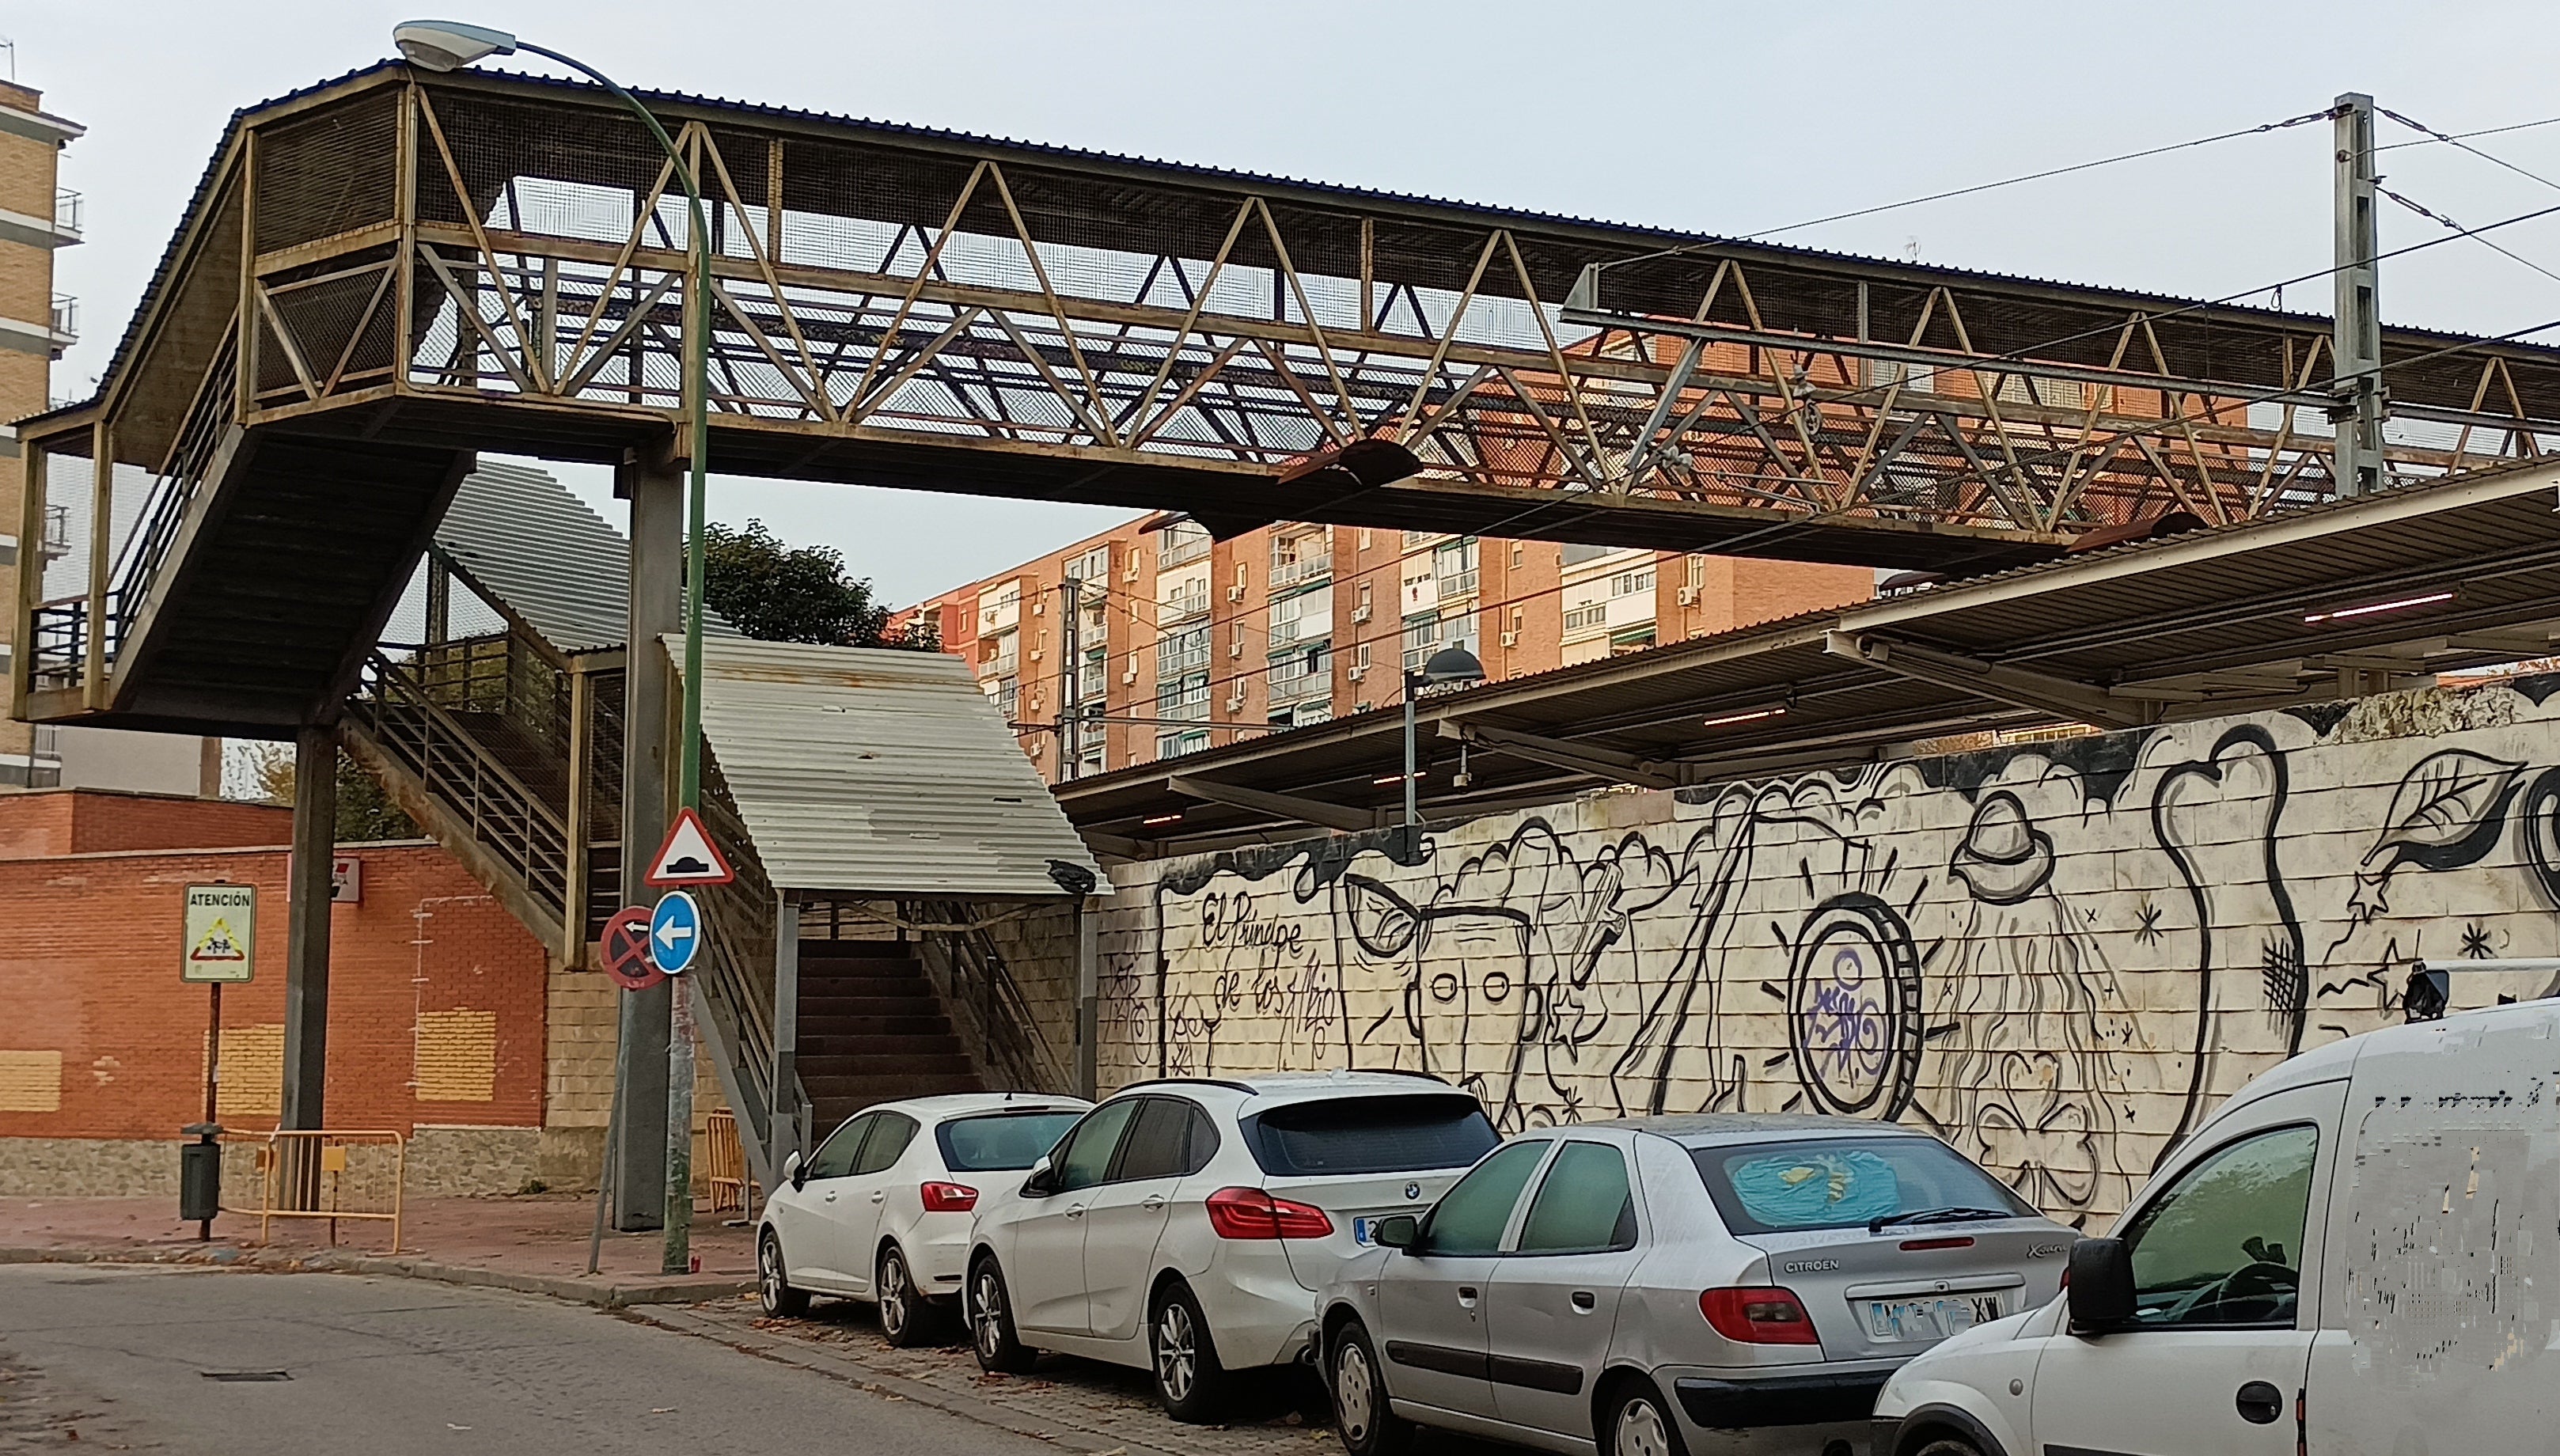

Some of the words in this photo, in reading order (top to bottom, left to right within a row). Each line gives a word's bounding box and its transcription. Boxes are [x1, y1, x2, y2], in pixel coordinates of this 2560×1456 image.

[190, 891, 250, 907] ATENCIÓN
[1202, 892, 1227, 947] El
[1215, 972, 1240, 1011] de
